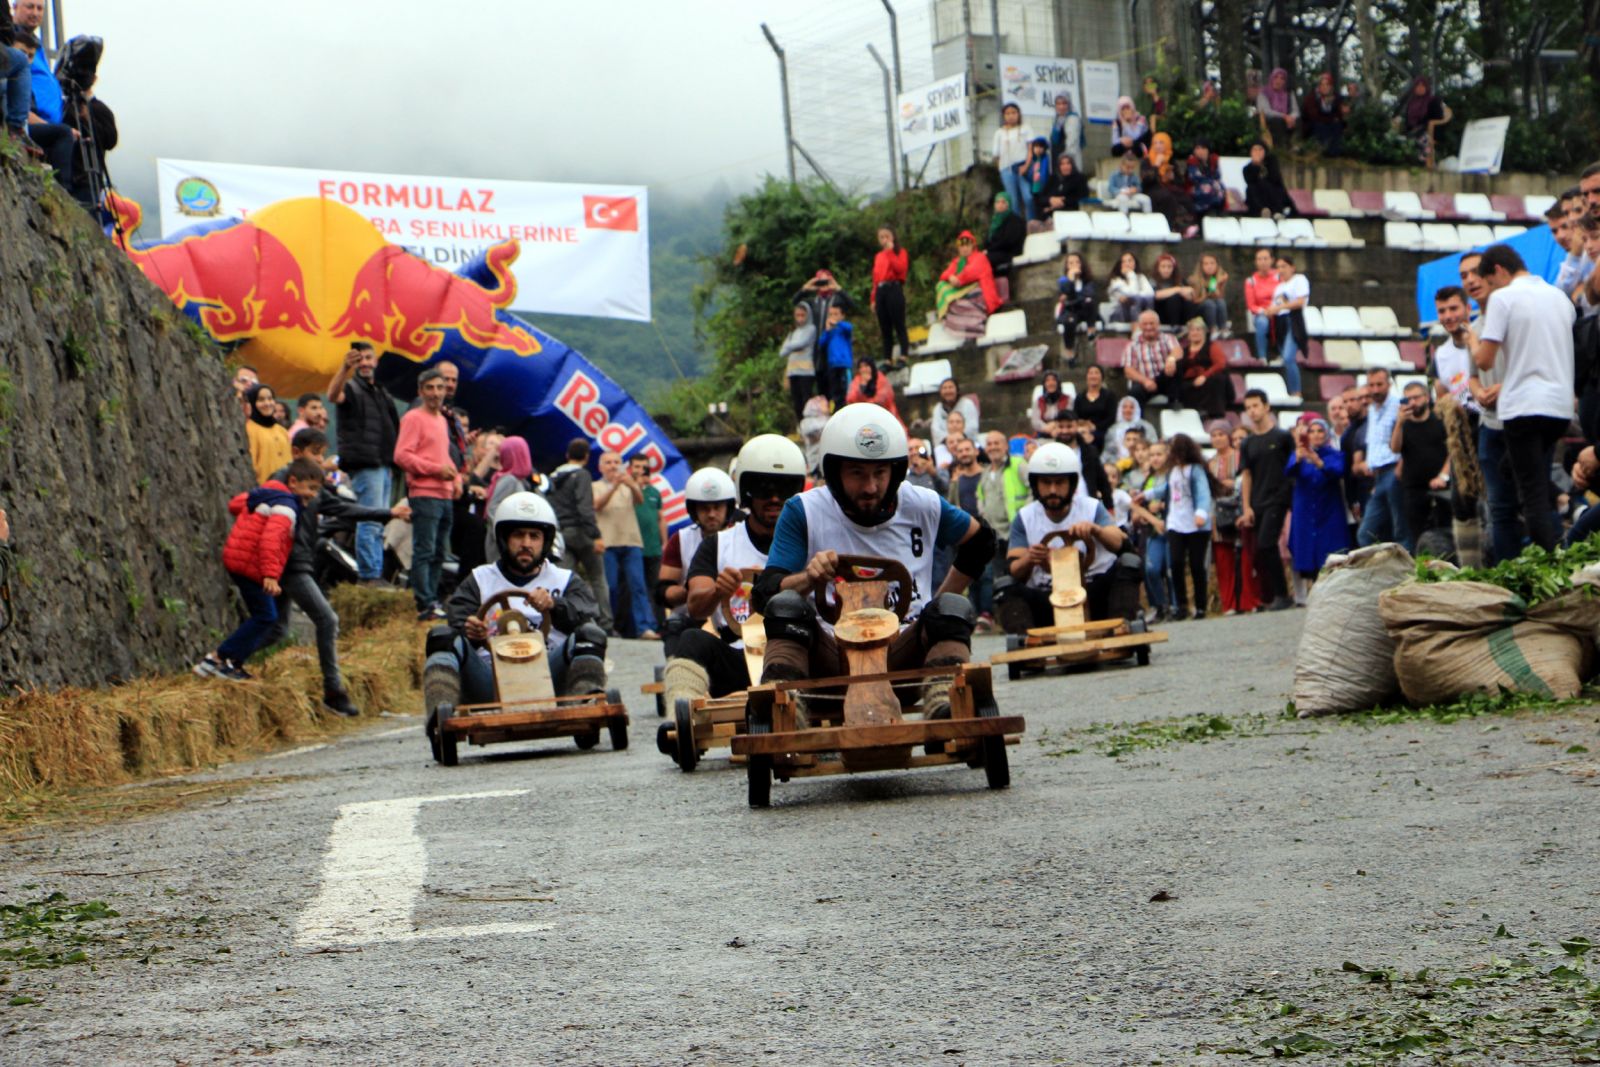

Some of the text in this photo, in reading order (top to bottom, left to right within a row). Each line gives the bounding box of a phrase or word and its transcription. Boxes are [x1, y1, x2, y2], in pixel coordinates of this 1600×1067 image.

[1035, 63, 1074, 84] SEYİRCİ
[933, 108, 960, 132] ALANI
[319, 180, 495, 213] FORMULAZ
[410, 218, 579, 243] ŞENLİKLERİNE
[555, 371, 647, 455] Red
[911, 527, 924, 558] 6
